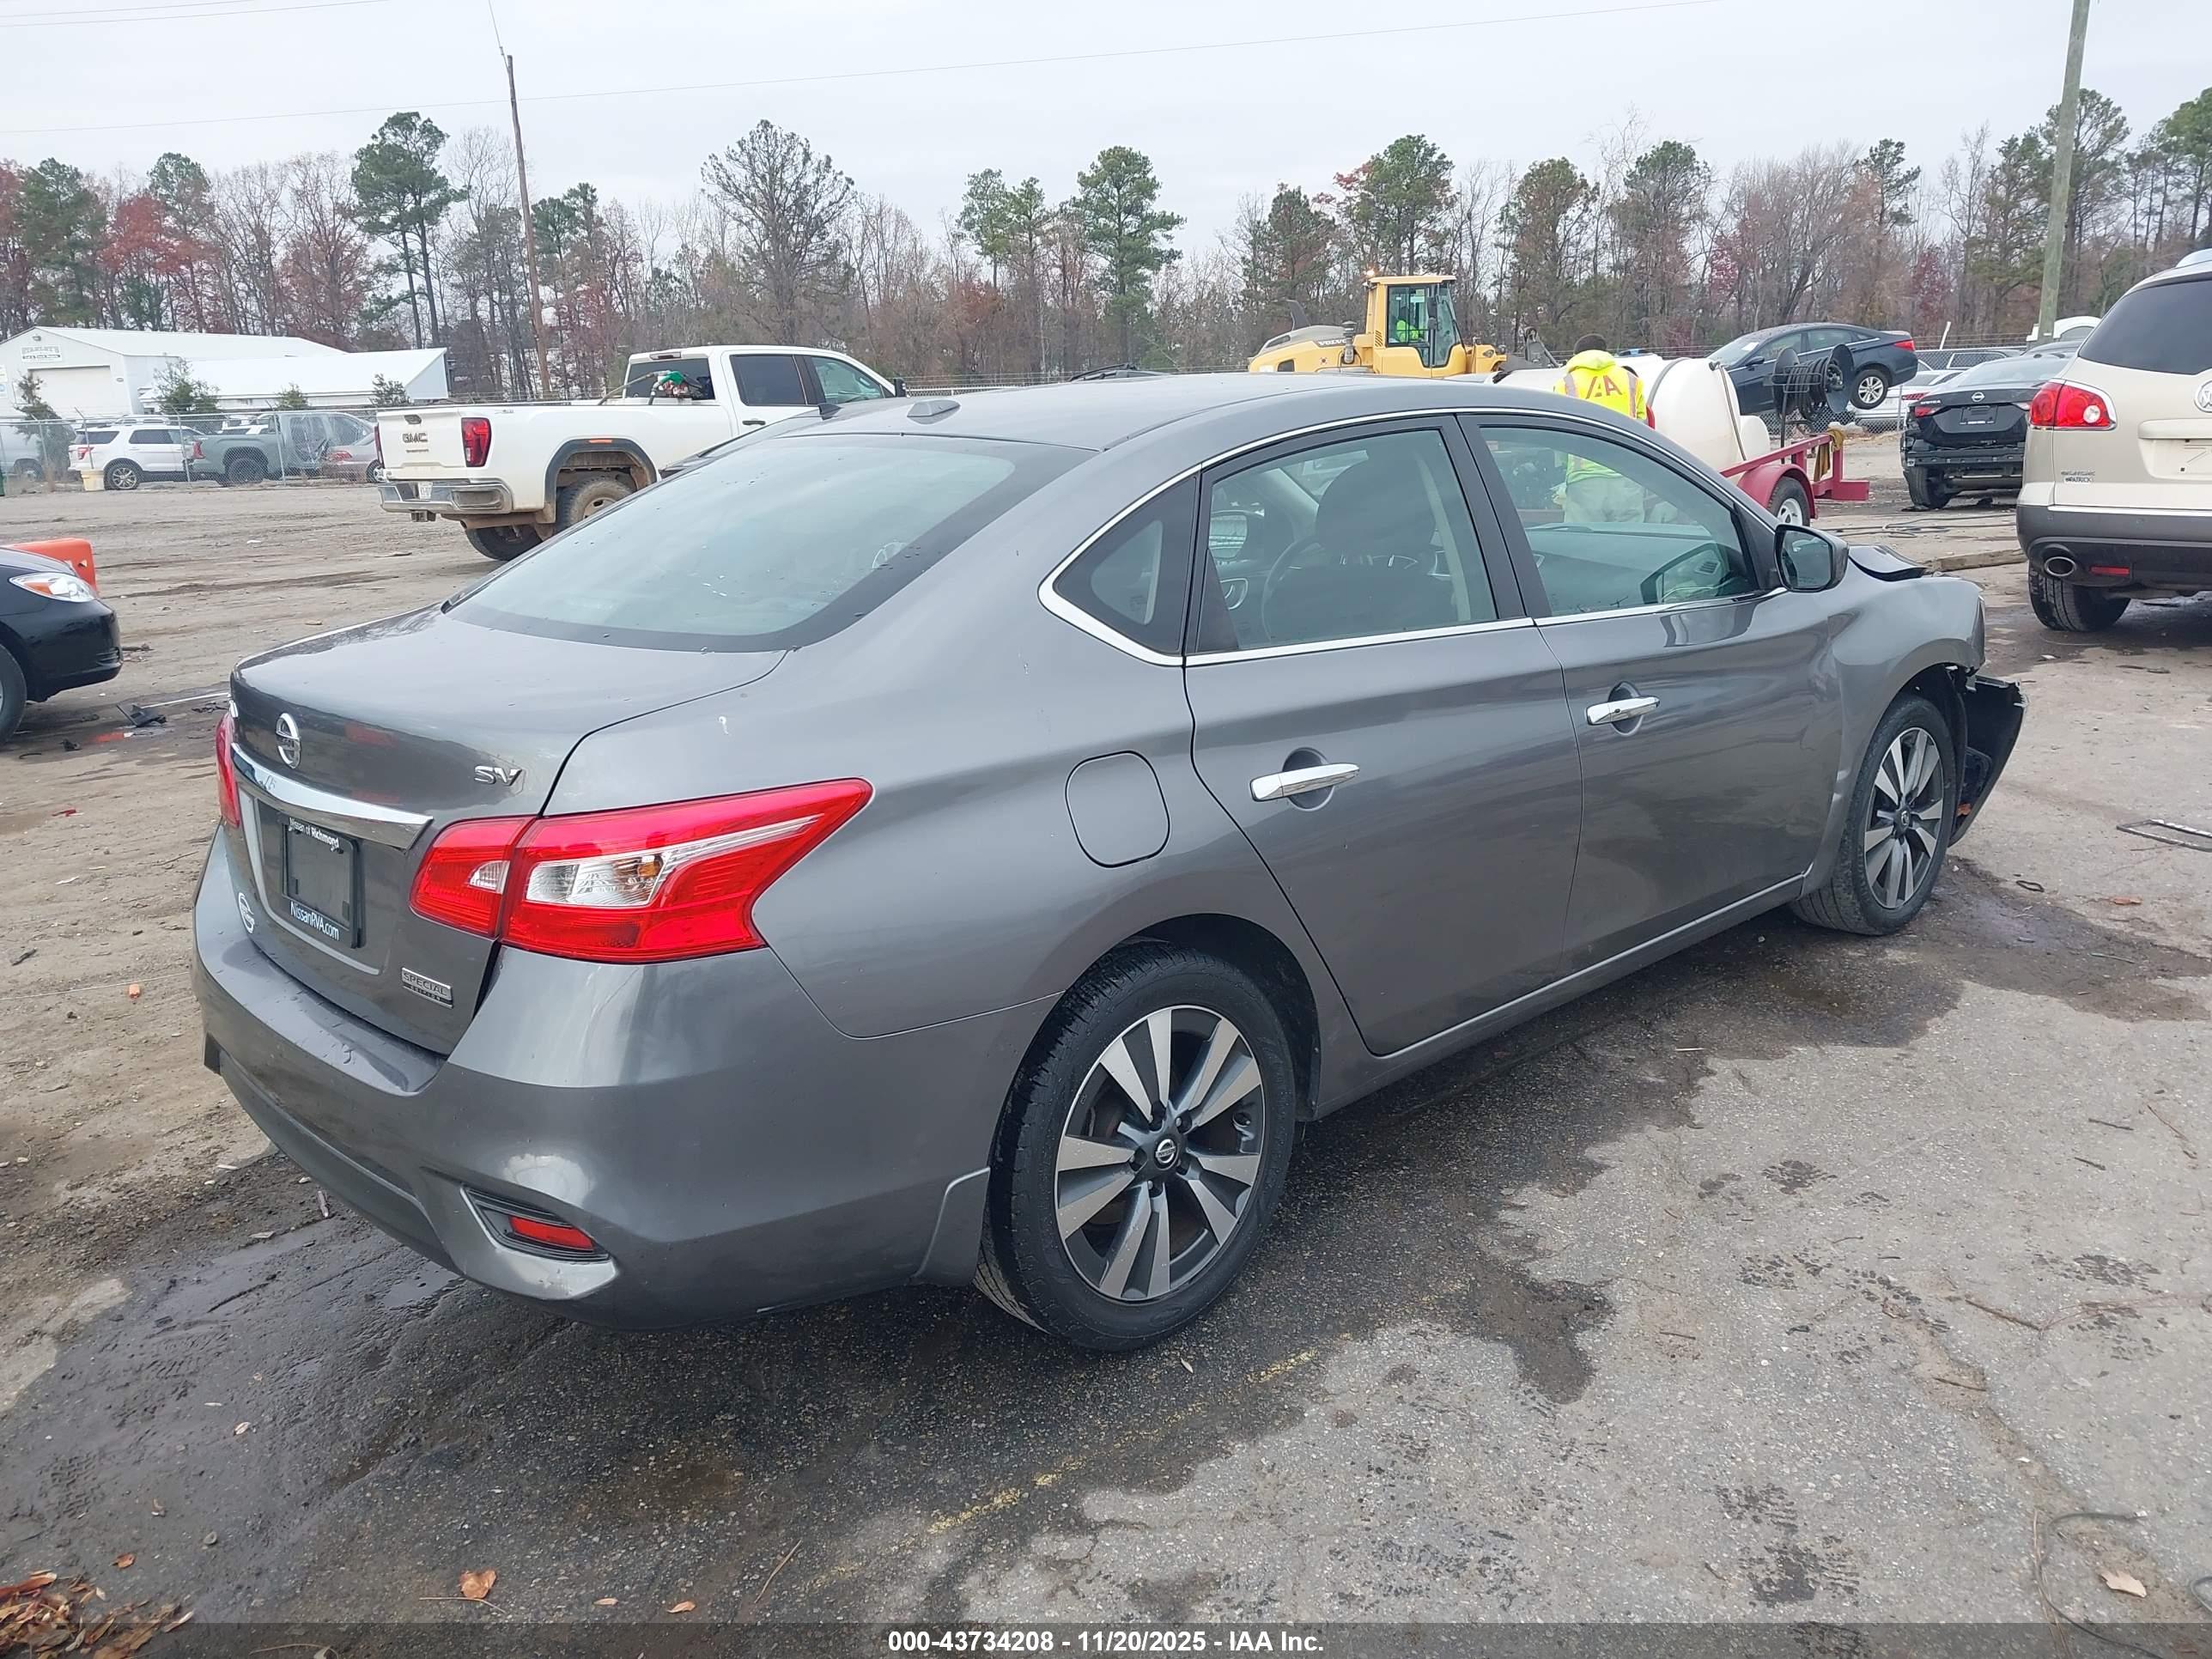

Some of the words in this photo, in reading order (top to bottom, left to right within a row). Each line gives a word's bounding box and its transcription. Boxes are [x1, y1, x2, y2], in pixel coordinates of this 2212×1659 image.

[403, 432, 428, 444] GMC
[474, 766, 522, 786] SV
[311, 826, 339, 847] Richmond
[290, 901, 339, 940] NissanRVA.com
[404, 972, 448, 996] SPECIAL
